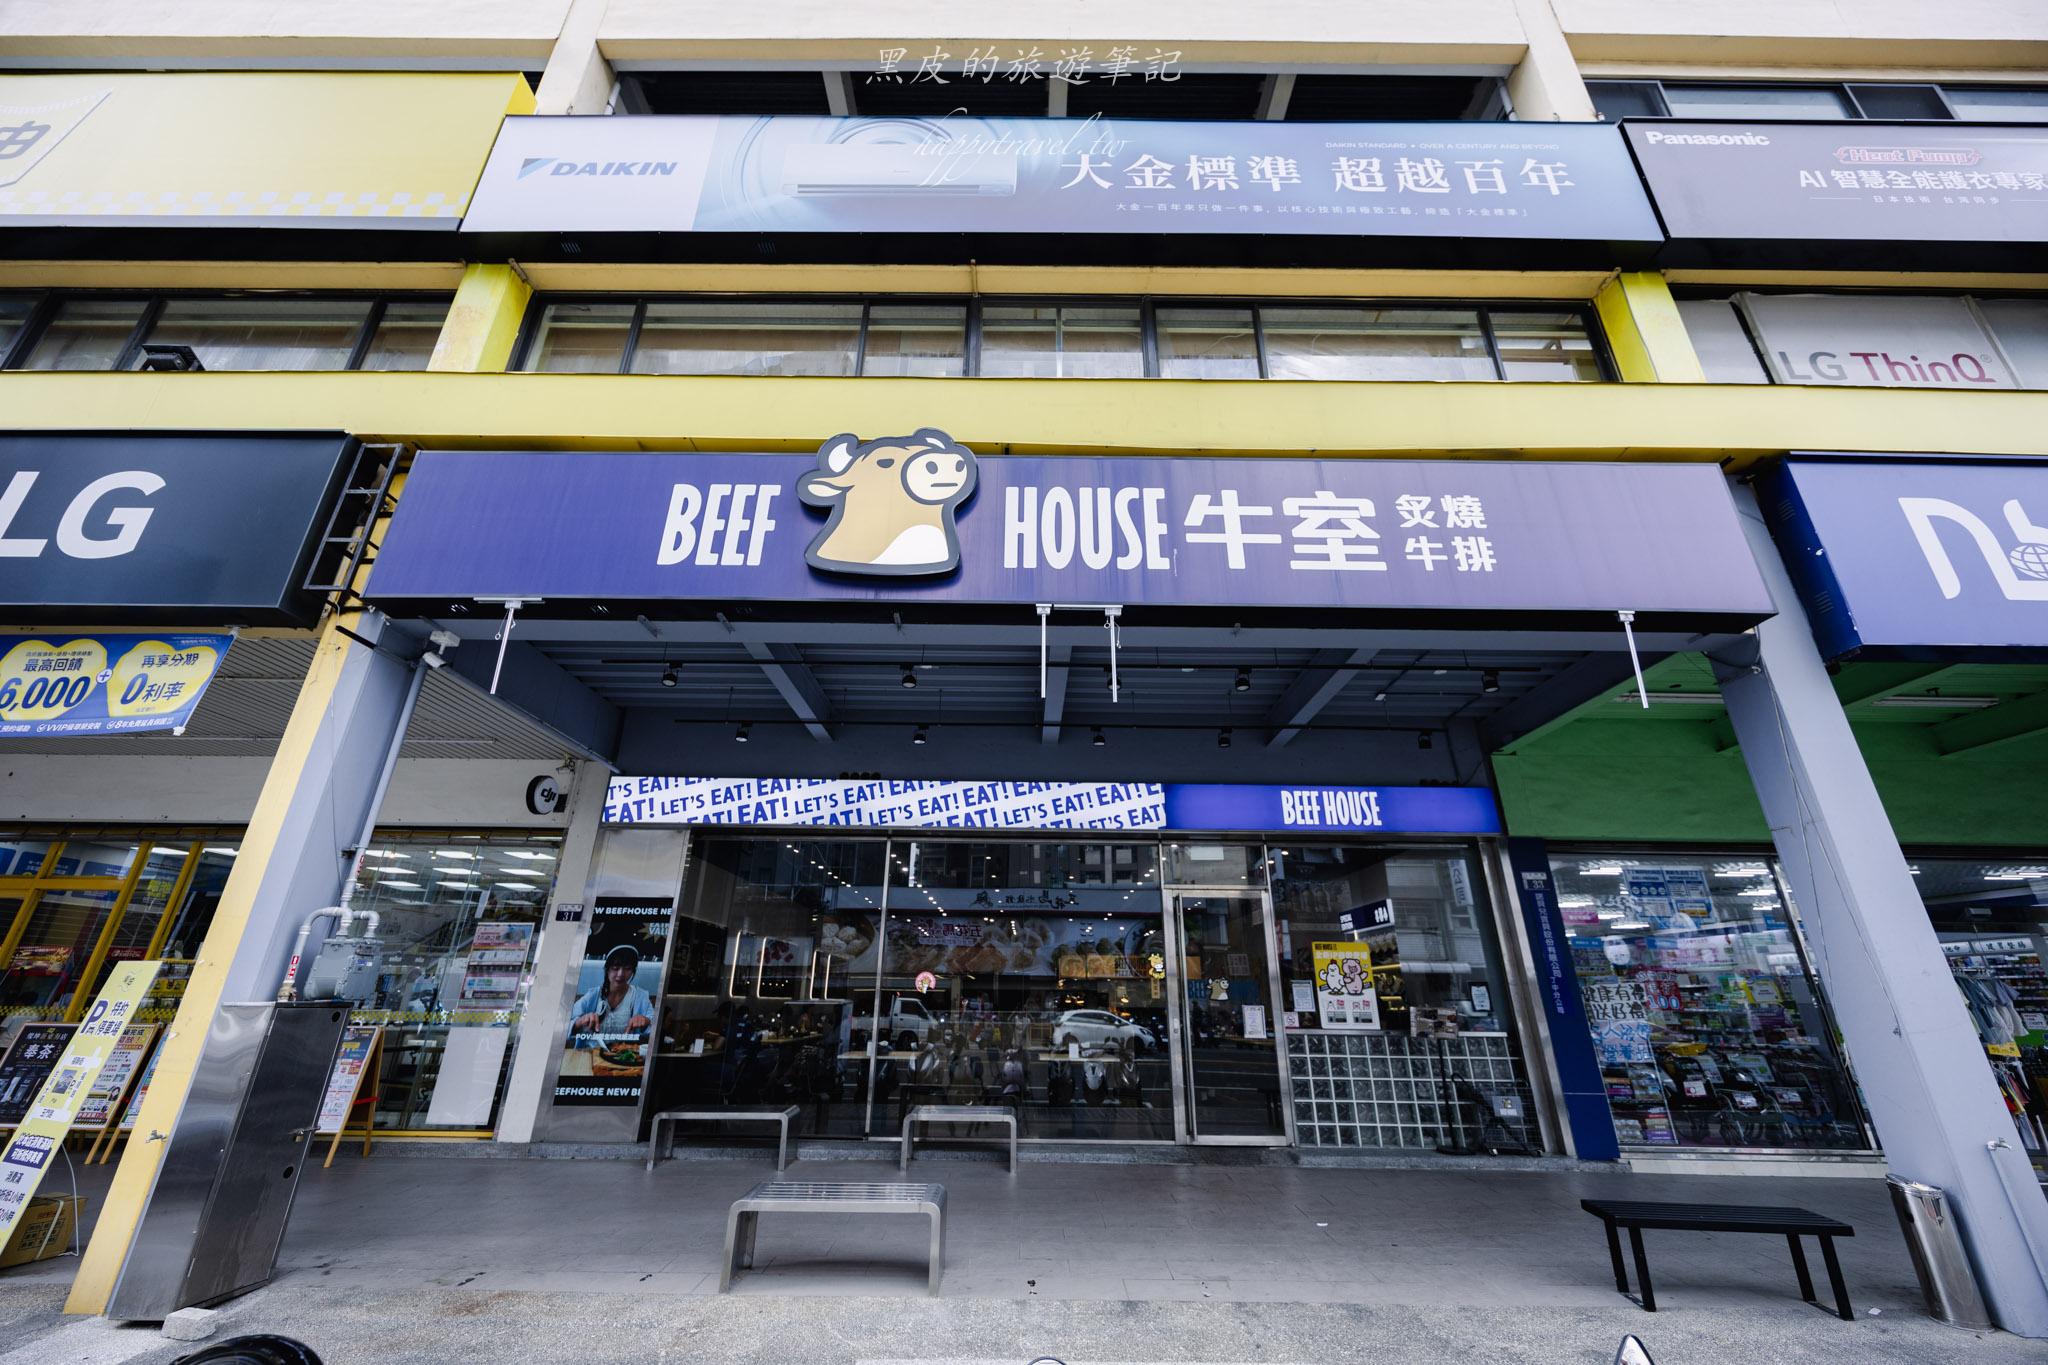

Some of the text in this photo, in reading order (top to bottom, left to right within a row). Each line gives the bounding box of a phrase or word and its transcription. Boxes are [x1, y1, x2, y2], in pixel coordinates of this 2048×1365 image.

[1645, 131, 1771, 147] Panasonic
[549, 160, 679, 177] DAIKIN
[1060, 152, 1576, 196] 大金標準 超越百年
[1800, 169, 2048, 191] AI 智慧全能護衣專家
[1778, 350, 1997, 384] LG ThinQ
[0, 470, 167, 560] LG
[656, 483, 1388, 572] BEEF HOUSE 牛室
[1395, 494, 1488, 530] 炙燒
[1405, 535, 1498, 572] 牛排
[23, 657, 84, 672] 最高回饋
[141, 652, 200, 669] 再享分期
[120, 672, 187, 705] 0利率
[661, 794, 705, 816] LET'S
[711, 783, 752, 806] EAT!
[737, 797, 789, 825] EAT!
[795, 793, 839, 815] LET'S
[844, 782, 885, 805] EAT!
[869, 804, 914, 827] LET'S
[918, 793, 960, 817] EAT!
[962, 782, 1009, 807] EAT!
[1003, 803, 1048, 826] LET'S
[1051, 792, 1094, 816] EAT!
[1280, 790, 1383, 827] BEEF HOUSE
[606, 906, 659, 915] BEEFHOUSE
[80, 1000, 109, 1034] P
[24, 1043, 56, 1060] 奉茶
[606, 1087, 630, 1096] NEW
